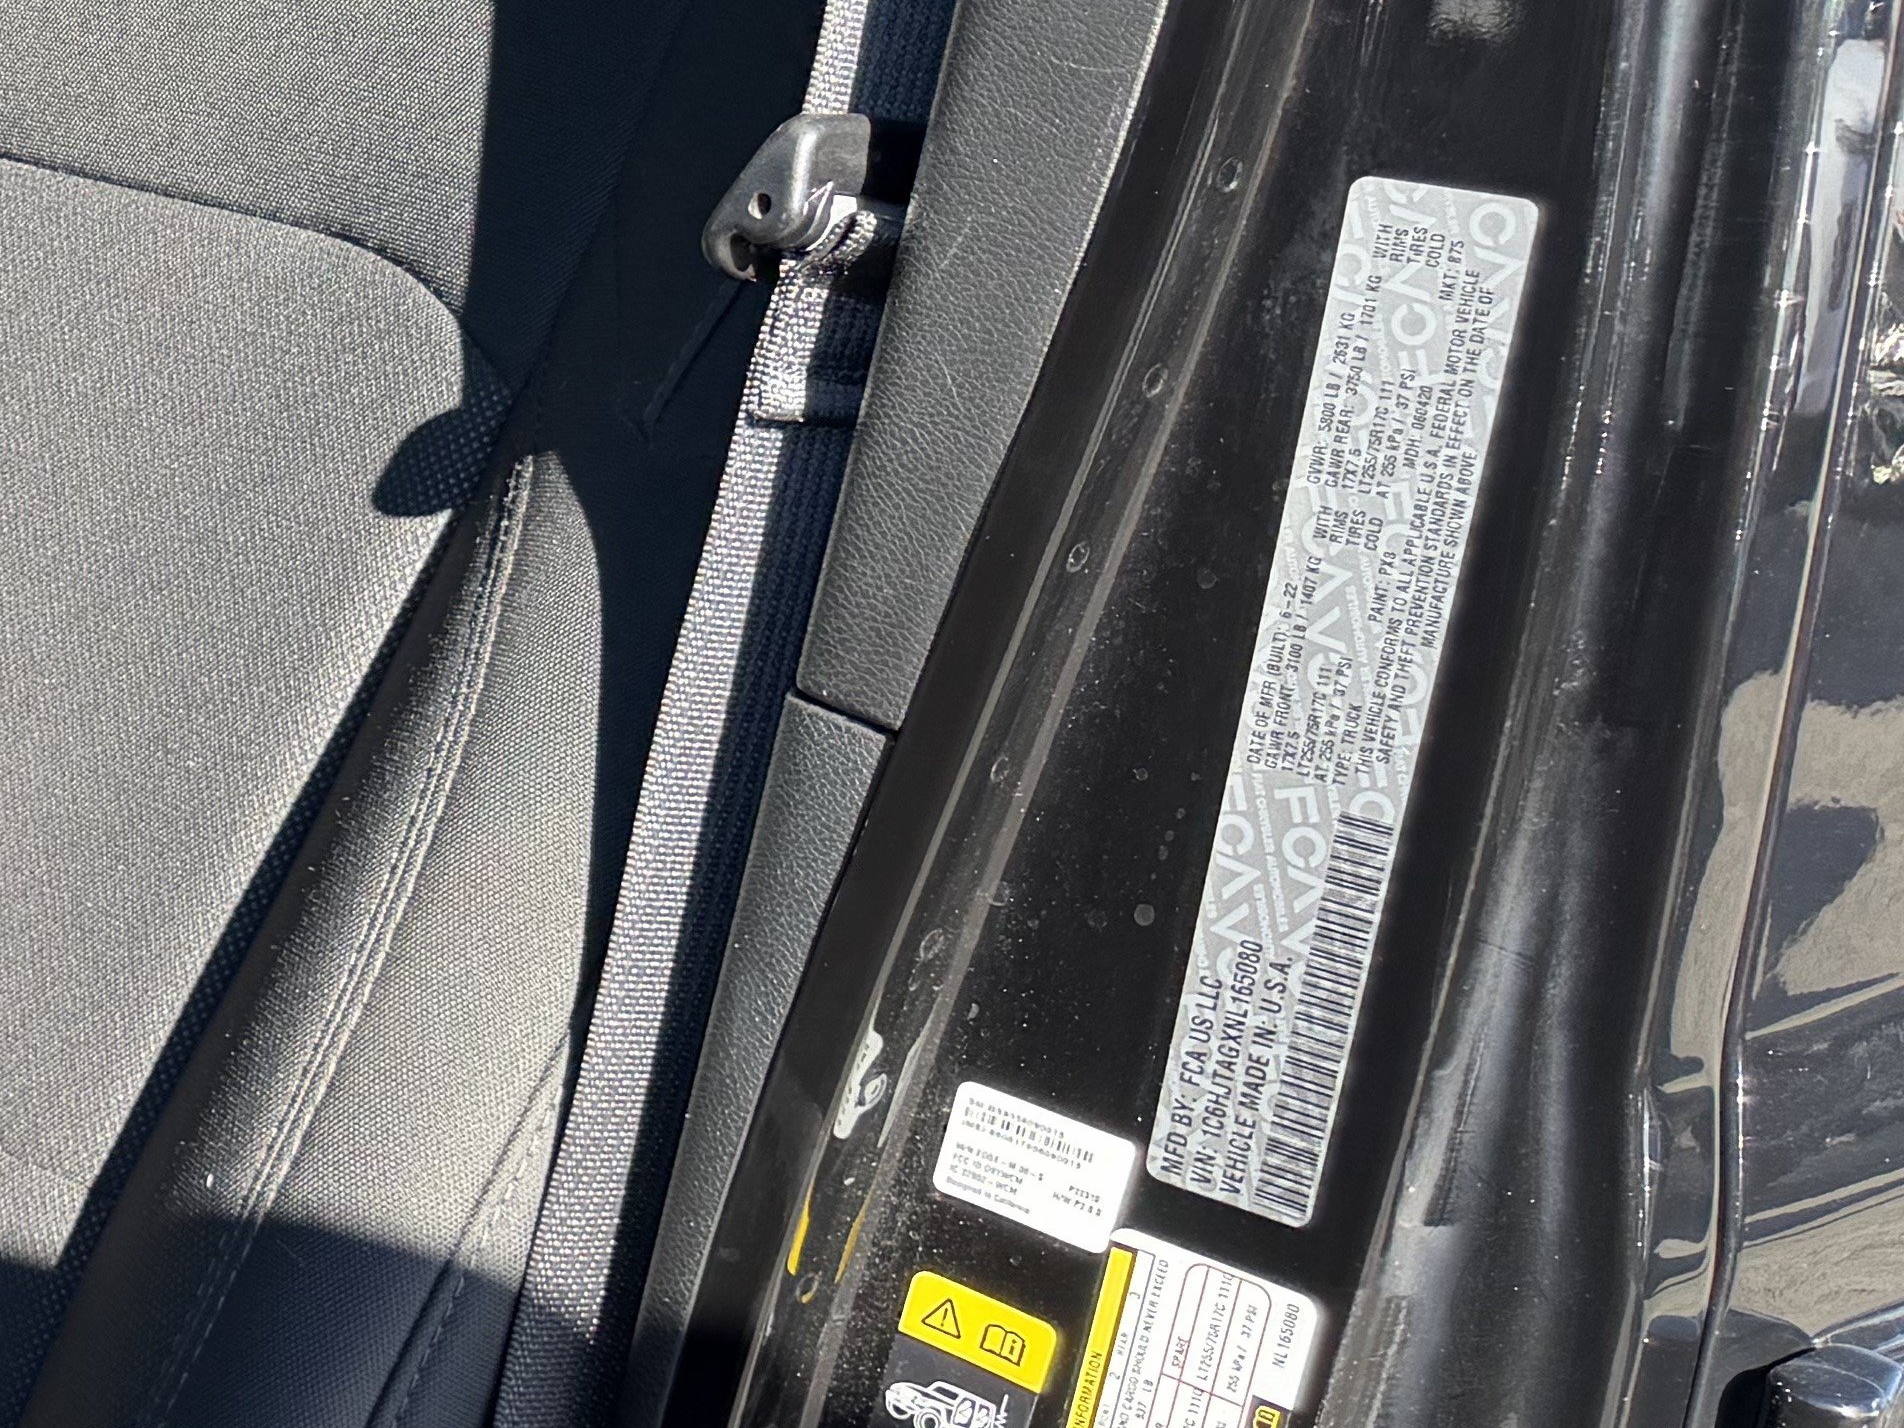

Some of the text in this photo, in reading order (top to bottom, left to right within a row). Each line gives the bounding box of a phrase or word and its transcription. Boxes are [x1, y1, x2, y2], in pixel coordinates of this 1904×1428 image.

[1371, 222, 1392, 259] WITH
[1424, 232, 1446, 268] COLD
[1364, 273, 1381, 291] KG
[1455, 268, 1481, 324] VEHICLE
[1337, 311, 1355, 330] KG
[1357, 297, 1376, 326] 1701
[1341, 227, 1409, 491] 17X7.5 RIMS
[1350, 344, 1366, 361] LB
[1357, 225, 1428, 494] LT255/75R17C 111 TIRES
[1444, 328, 1468, 375] MOTOR
[1323, 381, 1341, 399] LB
[1343, 364, 1362, 396] 3750
[1398, 367, 1417, 390] PSI
[1316, 401, 1337, 432] 5800
[1394, 393, 1411, 409] 37
[1429, 378, 1457, 439] FEDERAL
[1333, 403, 1354, 444] REAR:
[1385, 426, 1404, 451] kPa
[1306, 439, 1329, 484] GVWR:
[1324, 447, 1345, 488] GAWR
[1379, 453, 1398, 477] 255
[1341, 702, 1363, 745] TRUCK
[1367, 579, 1390, 623] PAINT:
[1401, 433, 1422, 469] MDH:
[1446, 239, 1466, 263] 875
[1375, 481, 1392, 499] AT
[1312, 504, 1332, 539] WITH
[1362, 516, 1383, 551] COLD
[1375, 285, 1495, 764] SAFETY AND THEFT PREVENTION STANDARDS IN EFFECT ON THE DATE OF
[1401, 486, 1432, 566] APPLICABLE
[1305, 555, 1321, 574] KG
[1395, 568, 1414, 593] ALL
[1419, 551, 1455, 648] MANUFACTURE
[1442, 497, 1467, 548] SHOWN
[1298, 577, 1317, 605] 1407
[1315, 665, 1332, 687] 111
[1345, 508, 1366, 547] TIRES
[1390, 596, 1407, 614] TO
[1280, 510, 1347, 772] 17X7.5 RIMS
[1291, 623, 1307, 640] LB
[1284, 643, 1303, 672] 3100
[1335, 655, 1353, 677] PSI
[1374, 617, 1403, 688] CONFORMS
[1258, 679, 1278, 708] MFR
[1331, 680, 1347, 697] 37
[1254, 710, 1271, 728] OF
[1322, 712, 1340, 737] kPa
[1362, 690, 1386, 743] VEHICLE
[1246, 729, 1267, 765] DATE
[1264, 729, 1285, 769] GAWR
[1317, 737, 1335, 761] 255
[1354, 745, 1374, 776] THIS
[1160, 973, 1222, 1176] MFD BY: FCA US LLC
[1190, 938, 1262, 1186] VIN: 1C6HJTAGXNL165080
[1219, 951, 1292, 1196] VEHICLE MADE IN: U.S.A.
[1271, 1302, 1302, 1369] NL165080
[1108, 1370, 1119, 1380] 2
